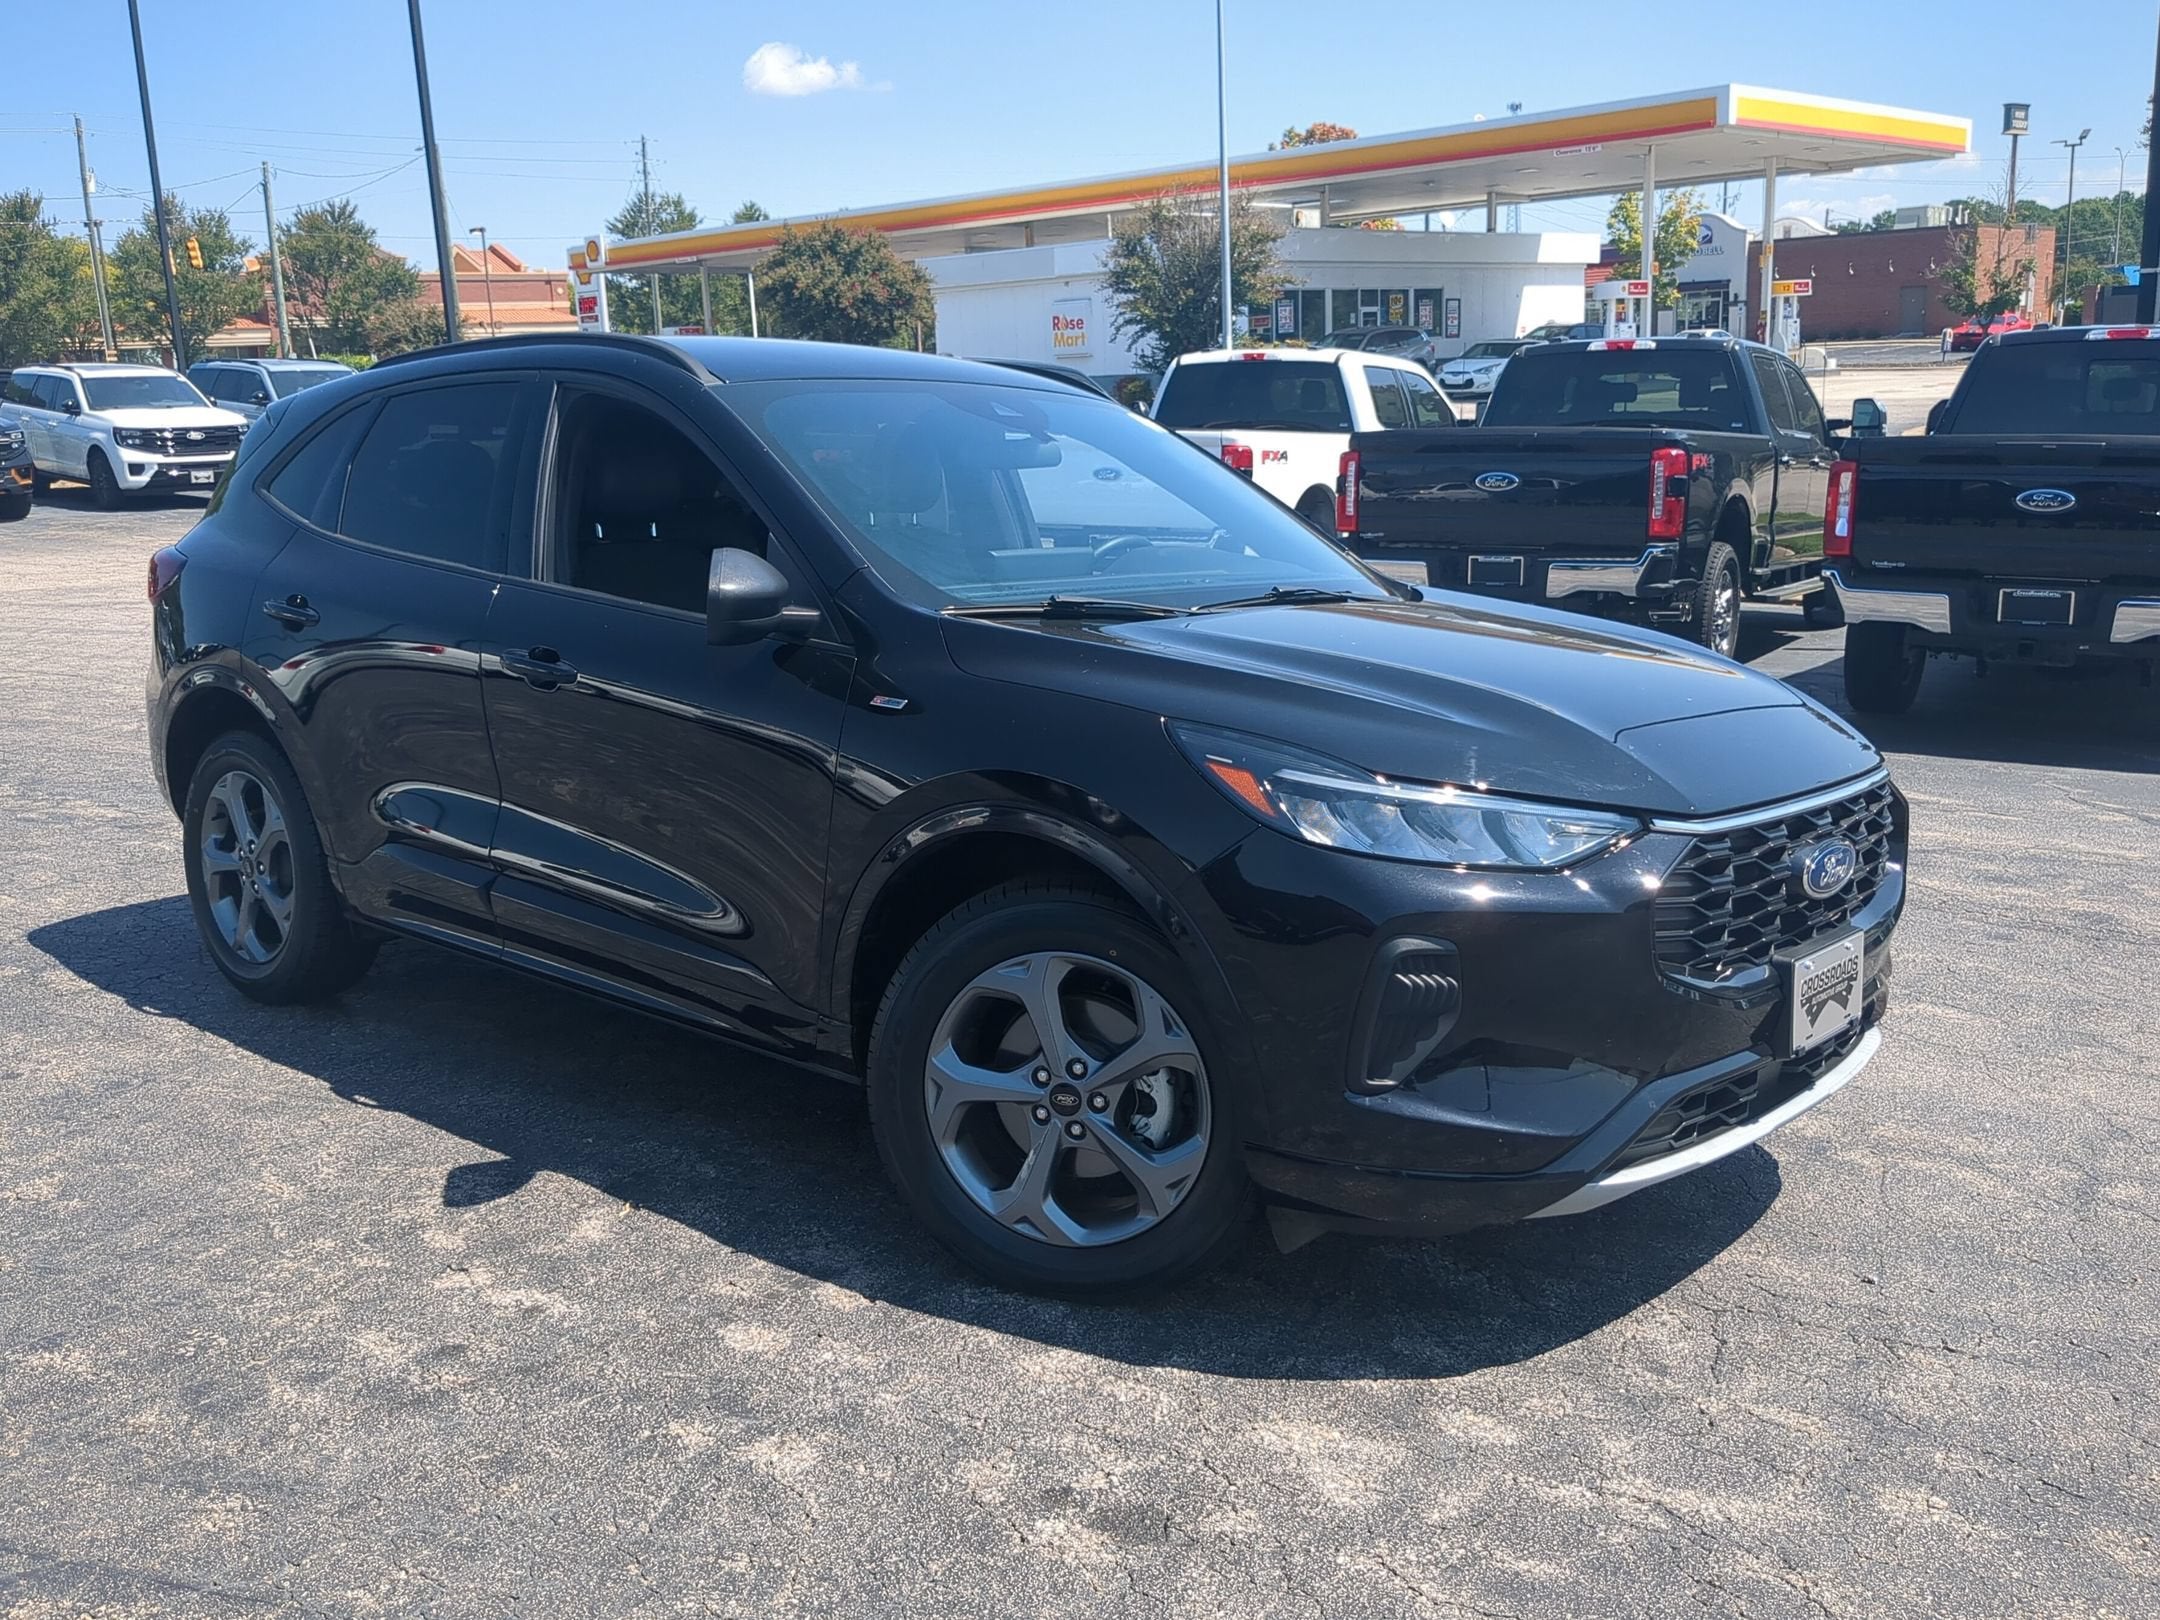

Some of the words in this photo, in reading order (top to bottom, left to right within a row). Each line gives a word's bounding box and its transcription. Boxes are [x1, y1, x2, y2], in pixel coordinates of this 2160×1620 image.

[1052, 314, 1085, 331] Rose
[1053, 332, 1086, 348] Mart
[1262, 450, 1288, 464] FX4
[1820, 853, 1850, 887] Ford
[1801, 954, 1859, 998] CROSSROADS
